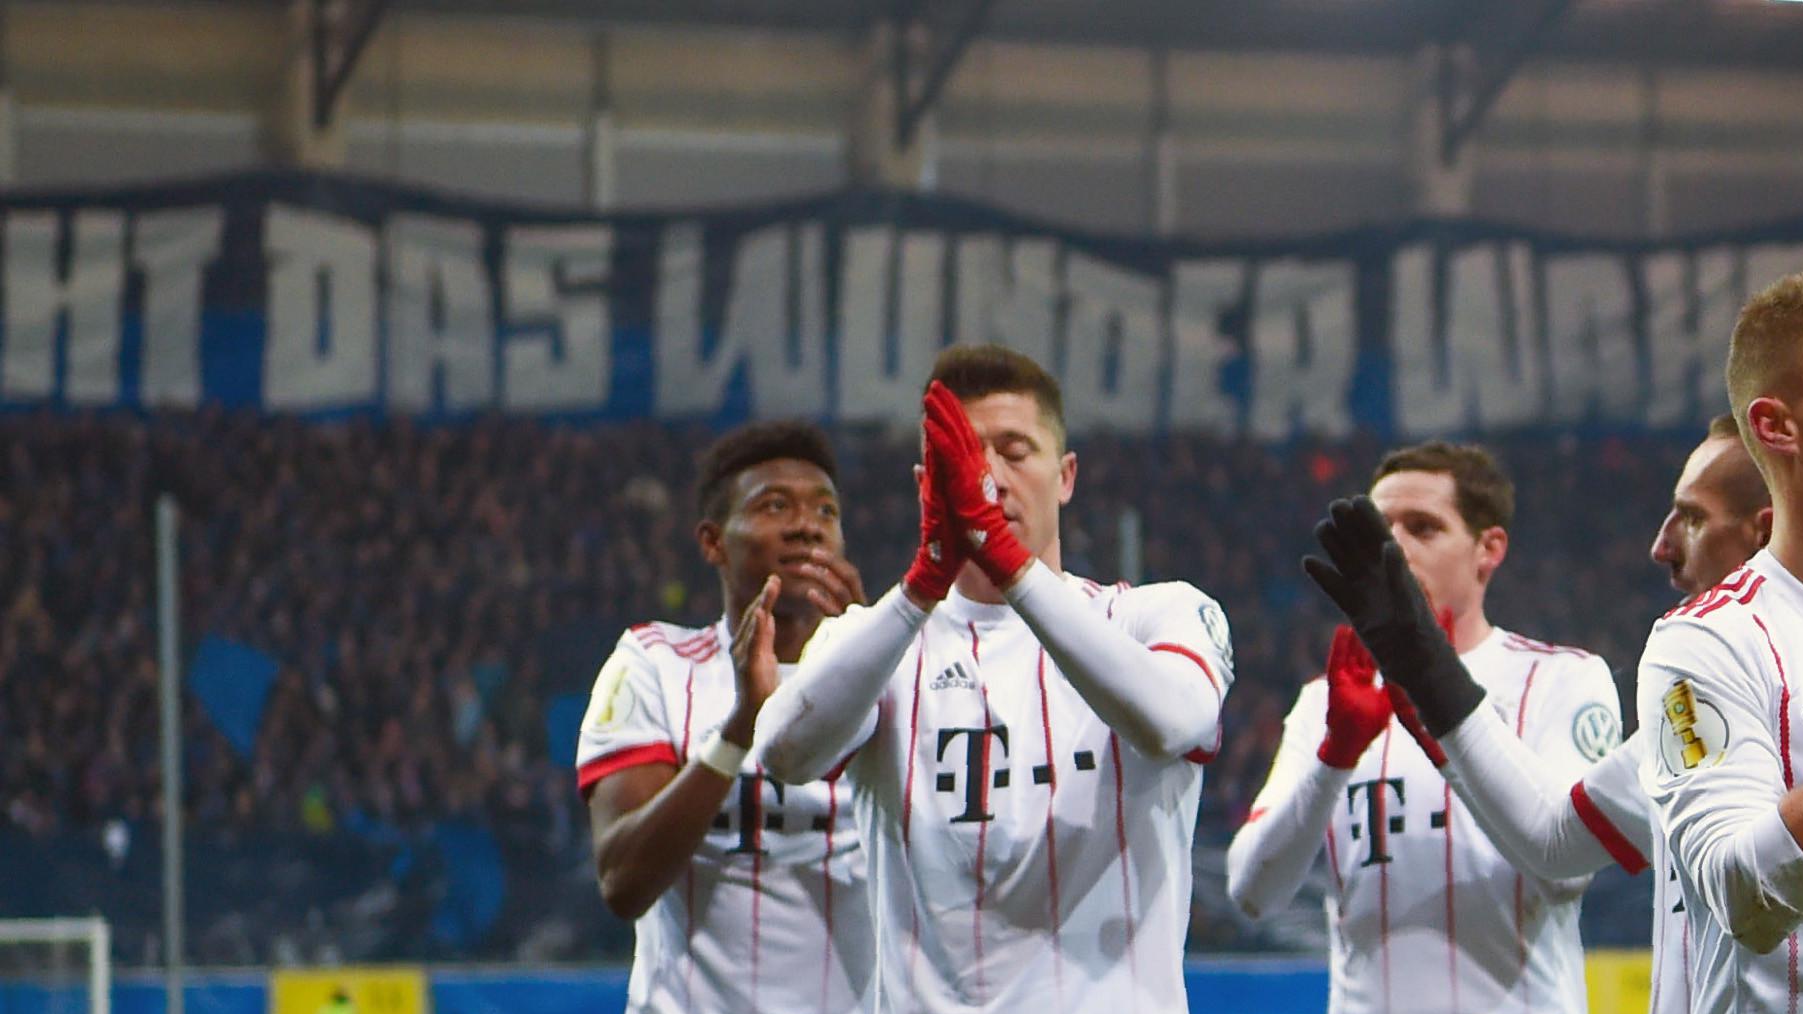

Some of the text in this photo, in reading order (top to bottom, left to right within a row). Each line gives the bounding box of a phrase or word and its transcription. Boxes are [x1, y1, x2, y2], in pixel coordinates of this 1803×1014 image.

[0, 205, 226, 402] HT
[262, 206, 612, 408] DAS
[655, 218, 1357, 440] WUNDER
